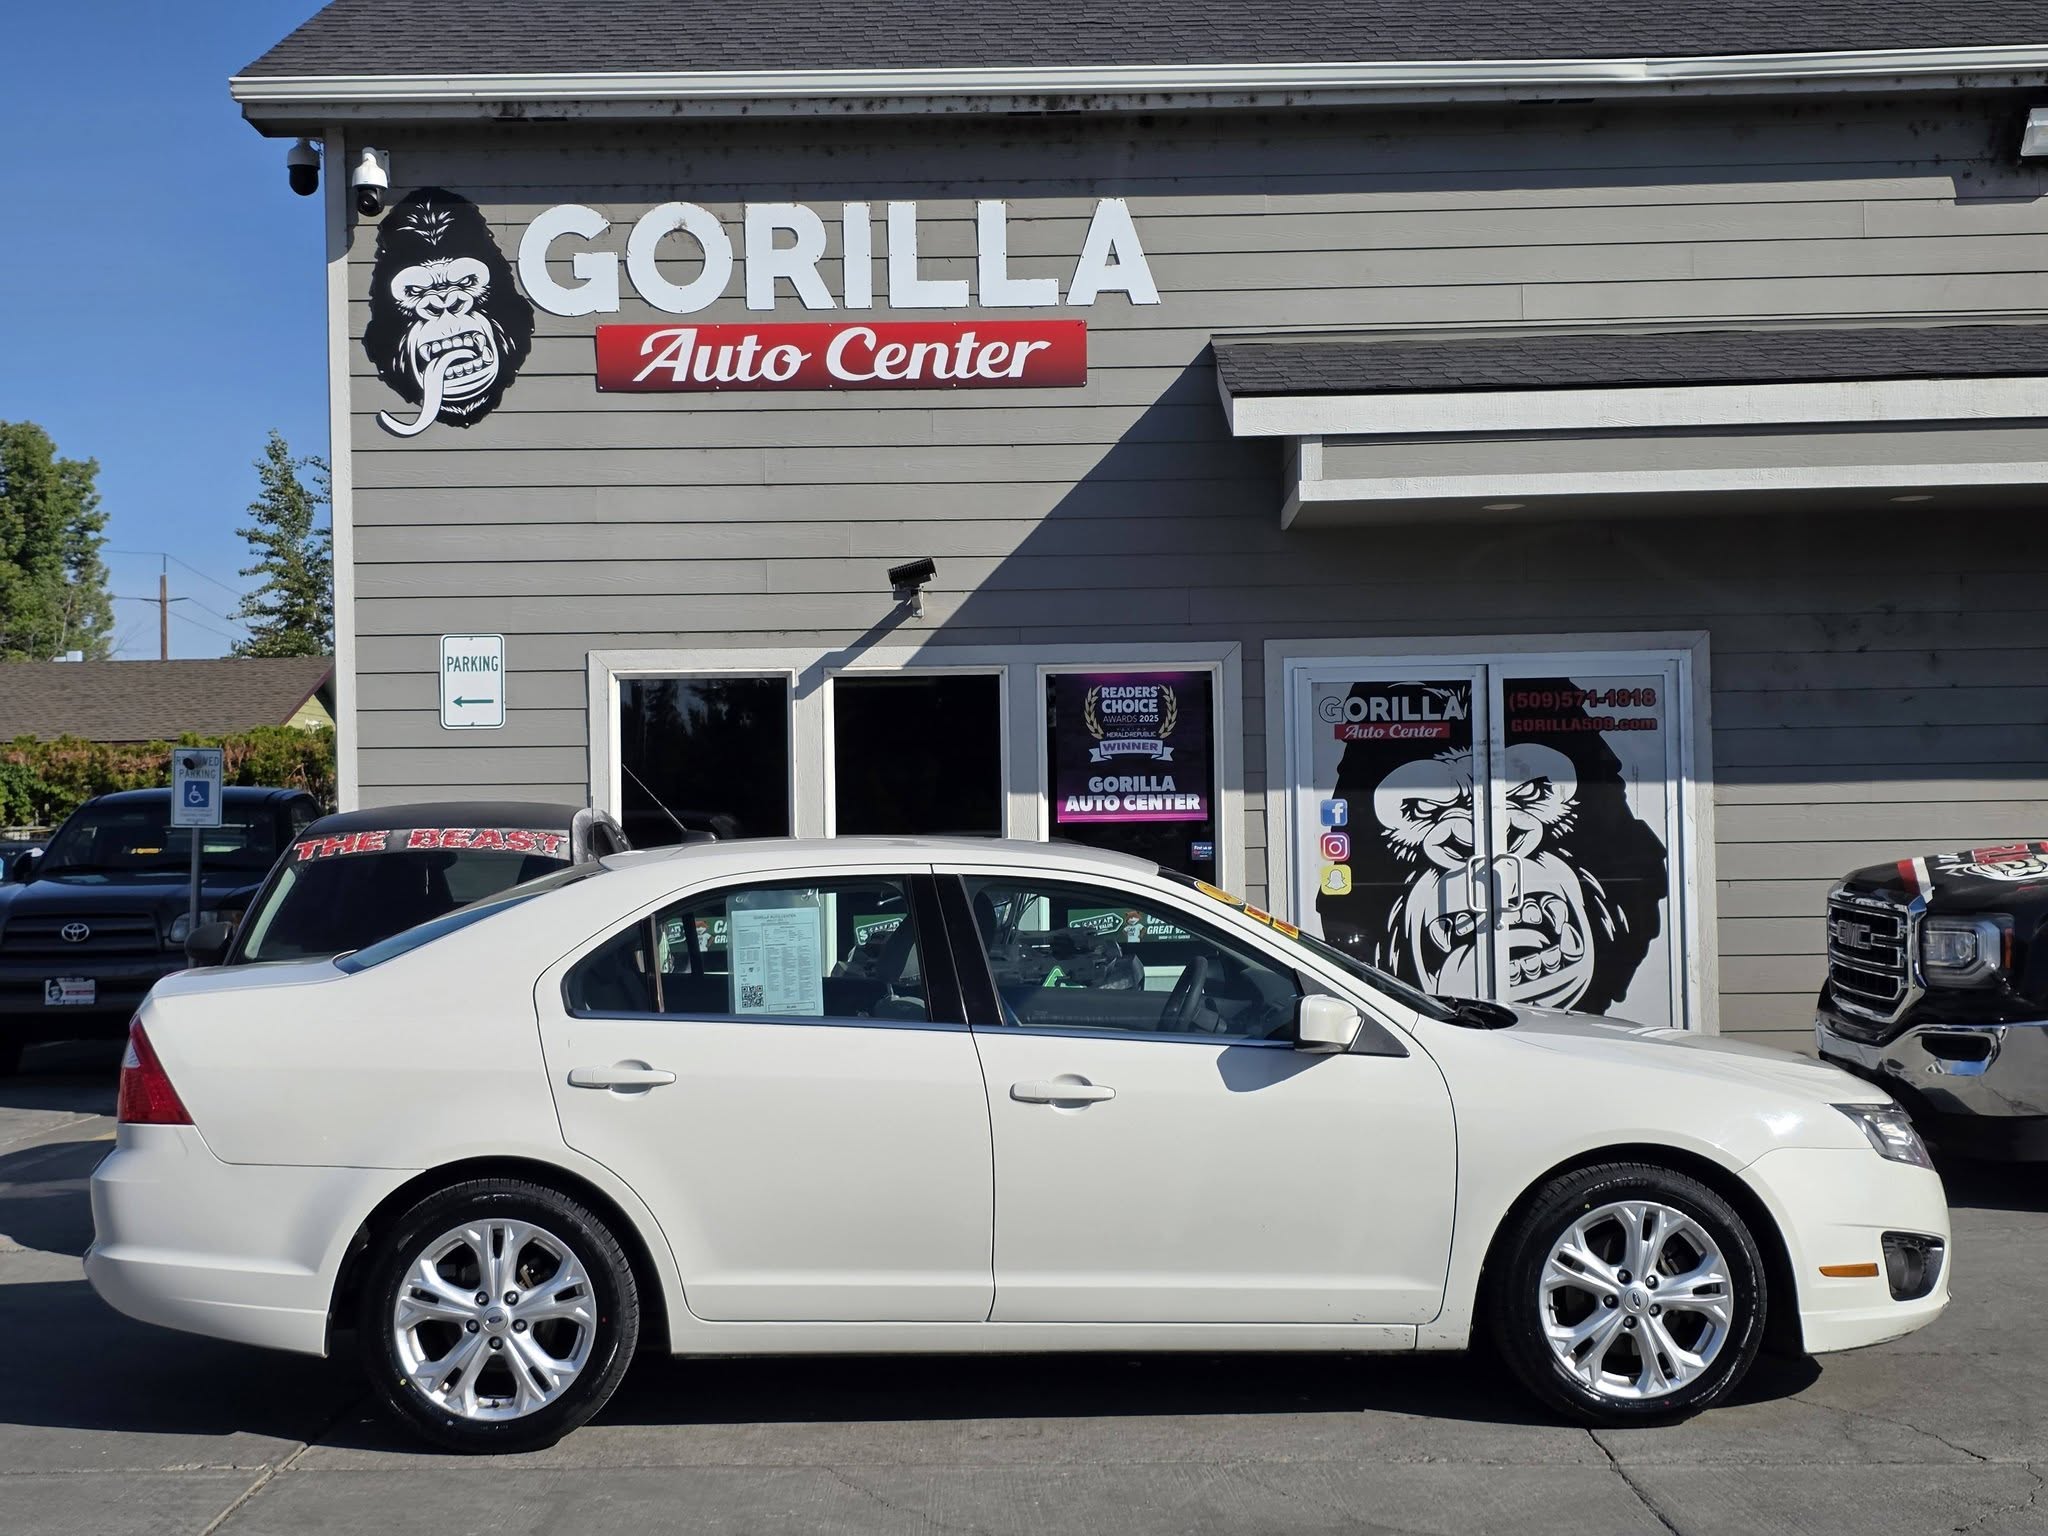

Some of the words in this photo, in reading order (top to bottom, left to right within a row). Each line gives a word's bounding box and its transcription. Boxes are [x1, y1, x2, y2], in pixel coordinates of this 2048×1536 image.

[517, 198, 1161, 316] GORILLA
[633, 328, 812, 382] Auto
[827, 327, 1051, 381] Center
[446, 655, 499, 673] PARKING
[1101, 686, 1160, 698] READERS'
[1508, 688, 1657, 712] (509)571-1818
[1101, 699, 1159, 713] CHOICE
[1318, 696, 1464, 723] GORILLA
[1102, 715, 1138, 723] AWARDS
[1139, 714, 1159, 723] 2025
[1344, 725, 1385, 739] Auto
[1389, 724, 1442, 739] Center
[1102, 742, 1159, 752] WINNER
[179, 769, 217, 779] PARKING
[1088, 775, 1176, 793] GORILLA
[1065, 795, 1120, 812] AUTO
[1123, 794, 1201, 811] CENTER
[293, 829, 390, 861] THE
[406, 828, 570, 854] BEAST
[1146, 925, 1175, 935] GREAT
[1837, 919, 1872, 949] GMC
